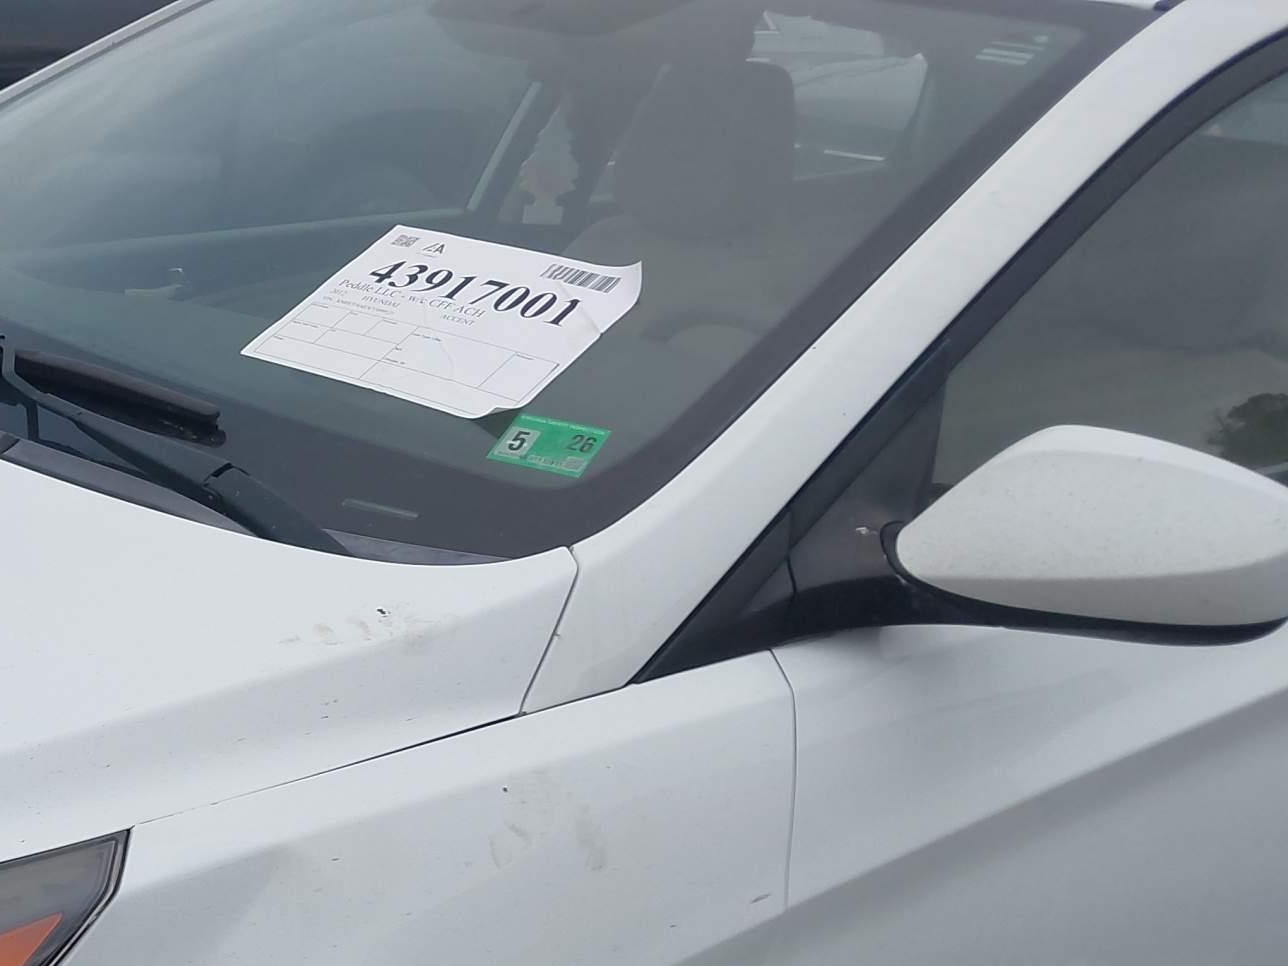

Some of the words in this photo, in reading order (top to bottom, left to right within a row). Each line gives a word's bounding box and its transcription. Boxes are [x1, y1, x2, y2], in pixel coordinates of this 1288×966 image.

[338, 279, 374, 292] Peddle
[374, 286, 402, 298] LLC
[452, 305, 486, 318] ACH
[368, 260, 582, 327] 43917001
[508, 430, 531, 451] 5
[567, 434, 597, 453] 26
